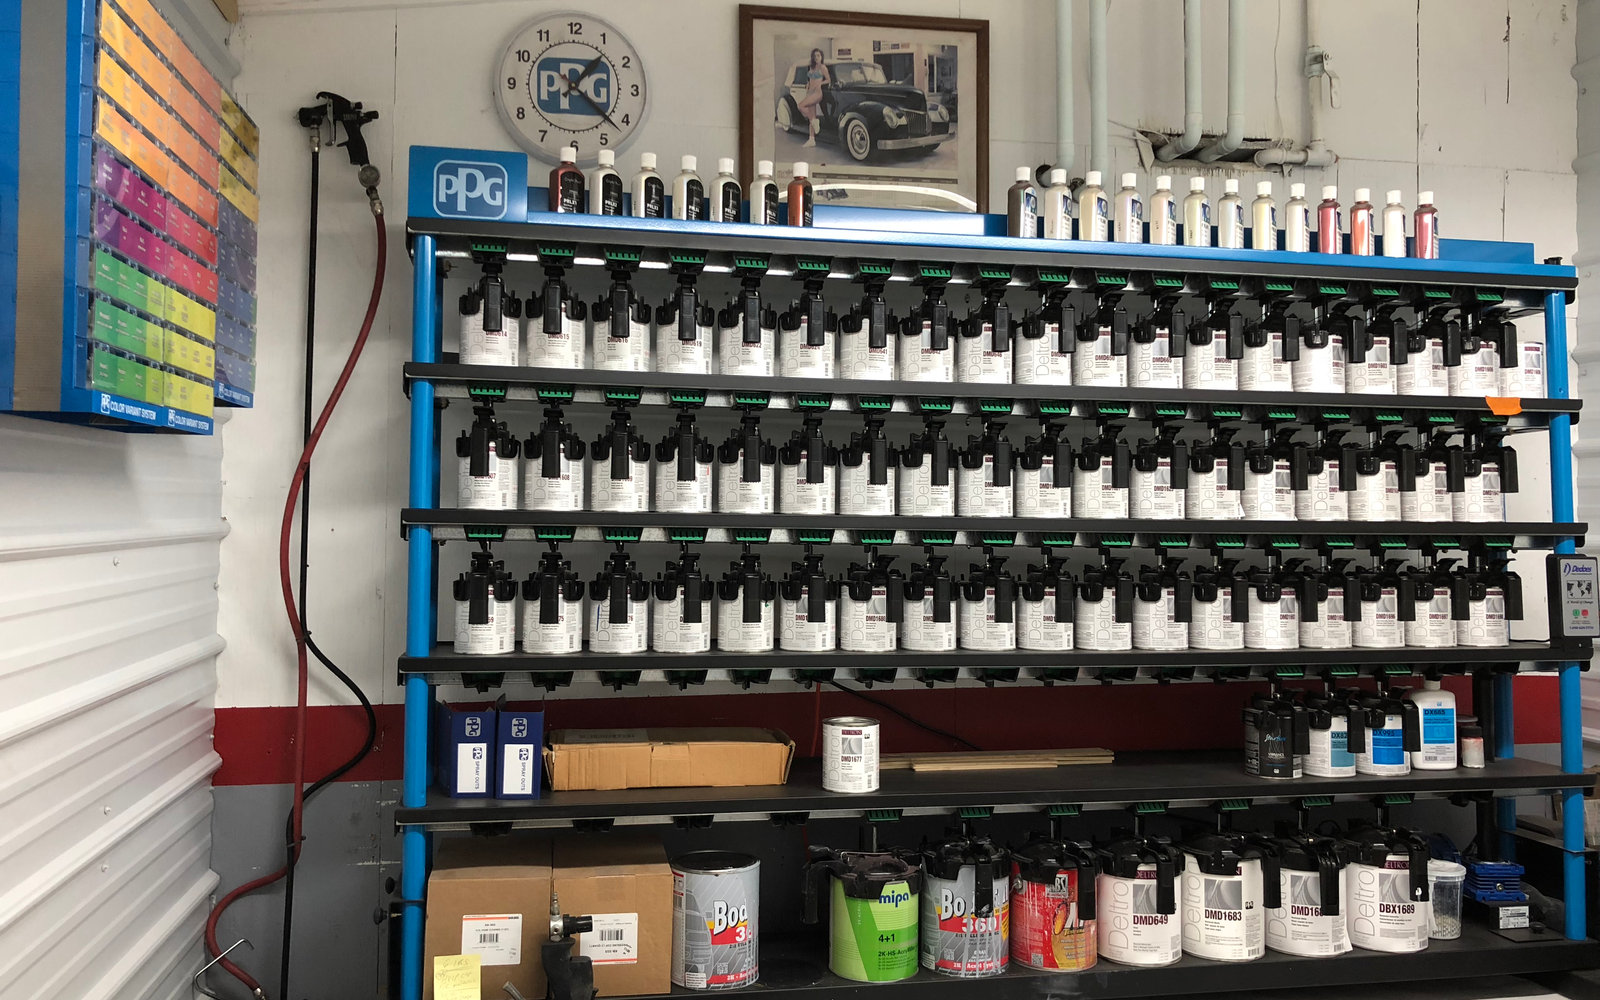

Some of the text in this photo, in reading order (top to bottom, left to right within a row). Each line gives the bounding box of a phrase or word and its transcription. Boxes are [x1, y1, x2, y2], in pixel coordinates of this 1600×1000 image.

[536, 29, 550, 42] 11
[568, 22, 582, 35] 12
[600, 33, 606, 44] 1
[516, 50, 530, 62] 10
[622, 56, 630, 68] 2
[507, 77, 516, 90] 9
[540, 62, 608, 110] PPG
[630, 84, 640, 96] 3
[516, 107, 526, 120] 8
[621, 114, 630, 126] 4
[538, 130, 548, 142] 7
[600, 133, 608, 146] 5
[438, 168, 502, 212] PPG
[596, 321, 606, 362] Deltro
[727, 327, 740, 367] Deltro
[786, 331, 798, 368] Deltro
[853, 331, 866, 372] Deltro
[968, 337, 981, 375] Deltro
[1034, 336, 1050, 375] Deltro
[1079, 341, 1094, 379] Deltro
[1137, 343, 1151, 381] Deltro
[110, 400, 125, 413] COLOR
[125, 404, 142, 416] VARIANT
[141, 408, 156, 420] SYSTEM
[224, 388, 232, 397] COLOR
[241, 394, 250, 404] SYSTEM
[175, 415, 186, 424] COLOR
[186, 418, 198, 428] VARIANT
[198, 420, 210, 430] SYSTEM
[597, 461, 609, 501] Deltro
[662, 463, 675, 501] Deltro
[725, 464, 738, 501] Deltro
[853, 464, 865, 504] Deltro
[915, 463, 930, 506] Deltro
[970, 469, 983, 506] Deltro
[1086, 471, 1100, 508] Deltro
[1139, 472, 1152, 509] Deltro
[1314, 473, 1328, 510] Deltro
[598, 599, 610, 641] Deltro
[664, 600, 678, 642] Deltro
[727, 601, 740, 640] Deltro
[783, 601, 795, 639] Deltro
[853, 602, 865, 640] Deltro
[910, 602, 922, 640] Deltro
[972, 602, 985, 639] Deltro
[1029, 602, 1042, 640] Deltro
[1096, 600, 1111, 640] Deltro
[1151, 600, 1166, 640] Deltro
[1207, 600, 1222, 639] Deltro
[467, 718, 480, 736] PPG
[513, 719, 526, 737] PPG
[829, 728, 840, 782] Deltron
[1136, 870, 1157, 879] DELTR
[878, 890, 909, 908] mipa
[1108, 881, 1129, 950] Deltro
[1205, 909, 1242, 921] DMD1683
[1291, 905, 1324, 916] DMD16
[1354, 866, 1375, 936] Deltro
[1379, 903, 1415, 914] DBX1689
[878, 934, 895, 942] 4+1
[962, 917, 997, 933] 360
[1133, 915, 1168, 926] DMD649
